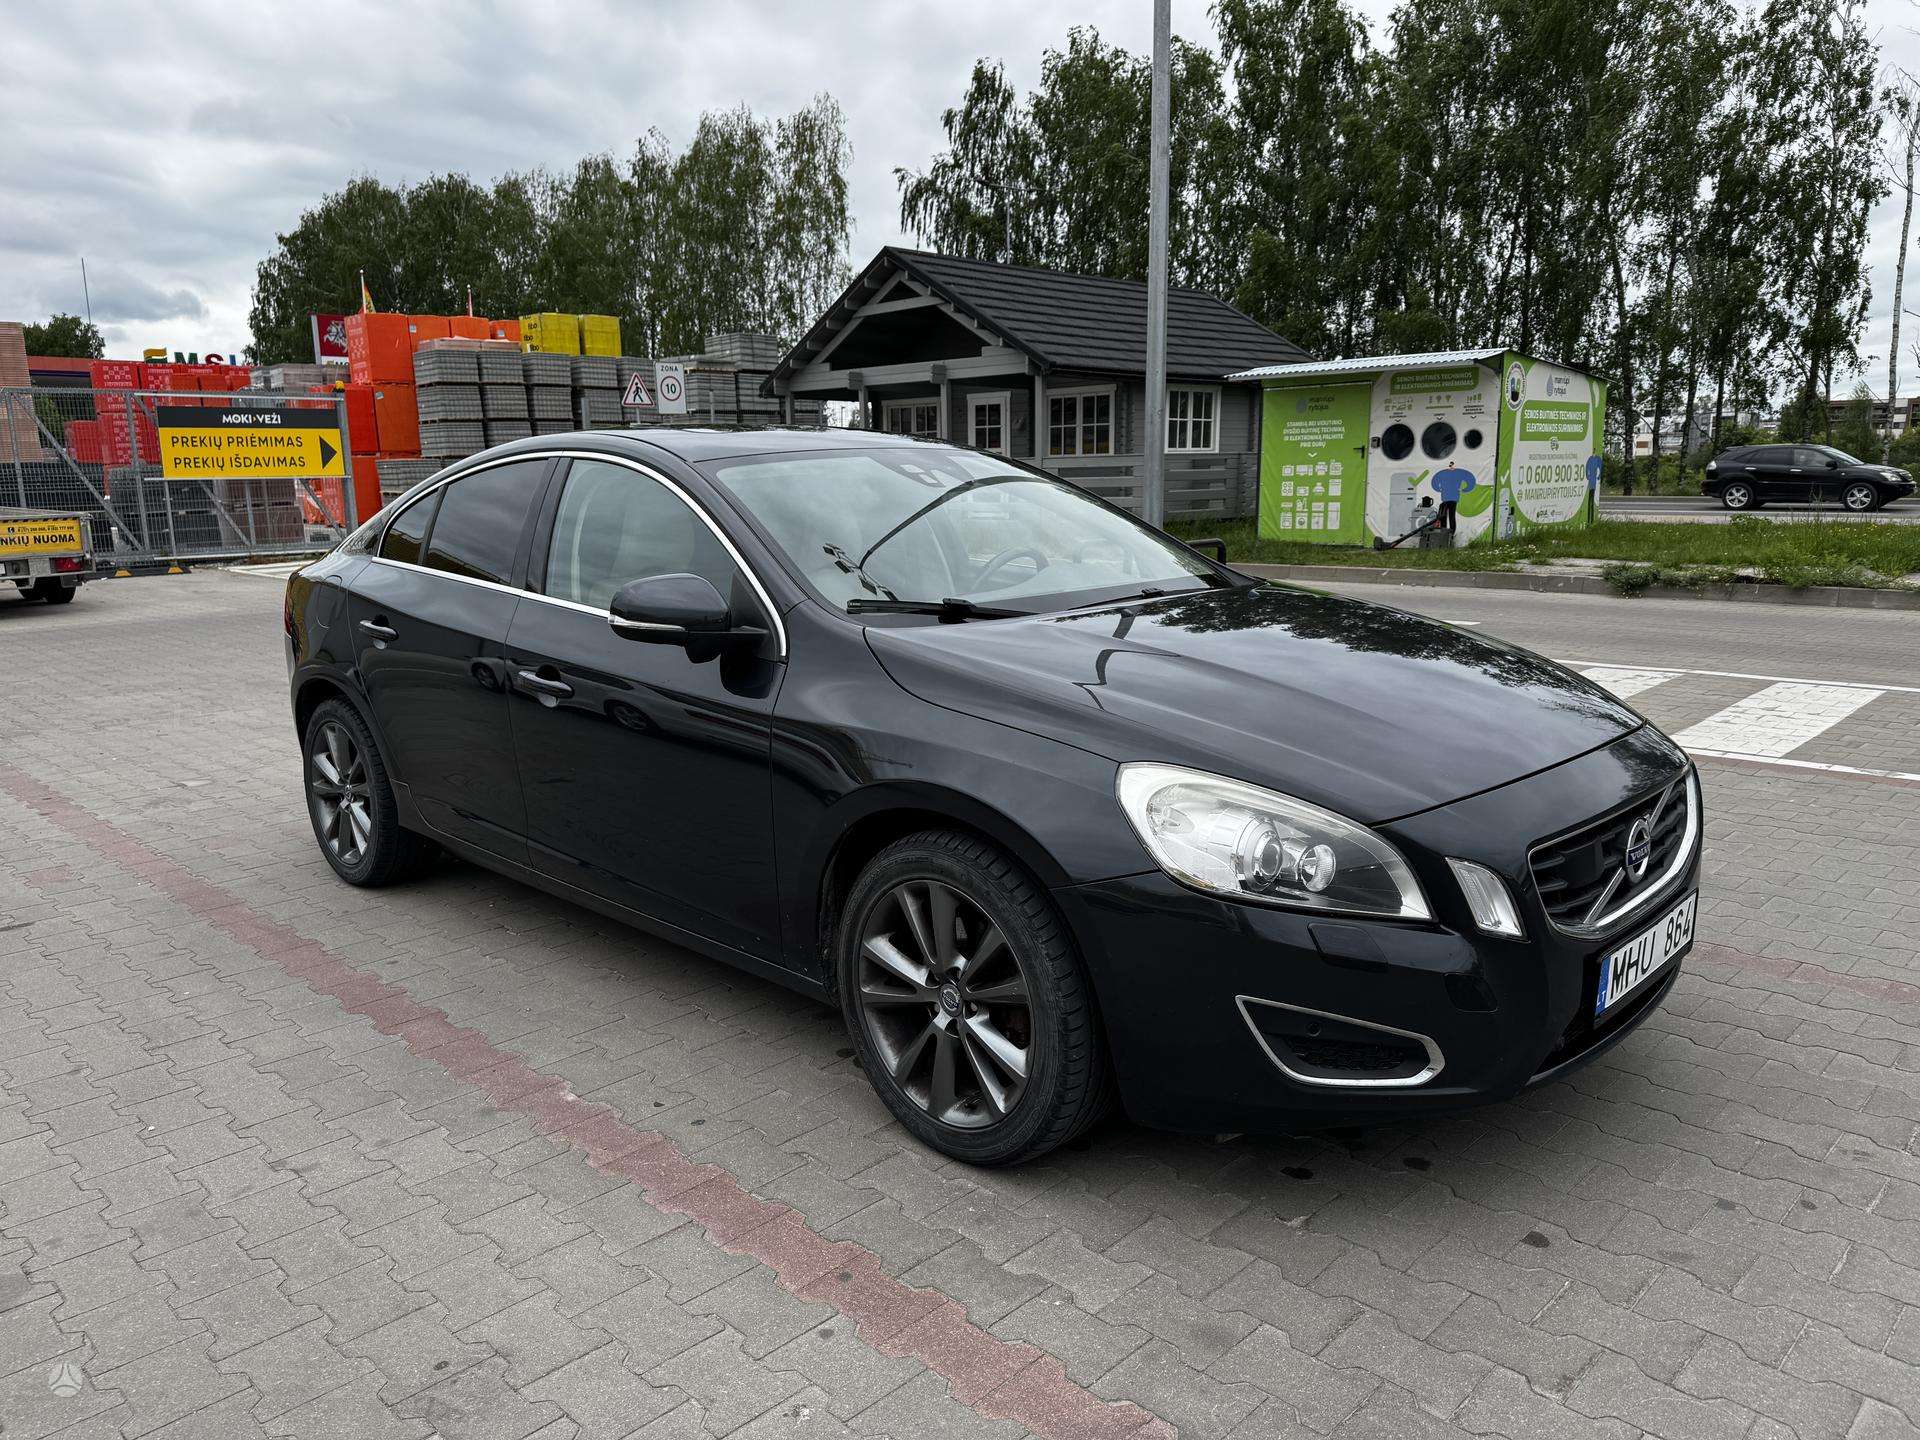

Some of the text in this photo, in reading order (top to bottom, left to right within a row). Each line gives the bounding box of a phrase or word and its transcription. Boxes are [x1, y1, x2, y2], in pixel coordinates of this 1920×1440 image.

[666, 383, 677, 394] 10
[171, 433, 303, 450] PREKIŲ PRIĖMIMAS
[173, 453, 306, 471] PREKIŲ IŠDAVIMAS
[1535, 464, 1553, 484] 600
[1555, 464, 1572, 483] 900
[1574, 464, 1585, 481] 30
[33, 534, 75, 544] NUOMA
[1610, 901, 1692, 1000] MHU 864
